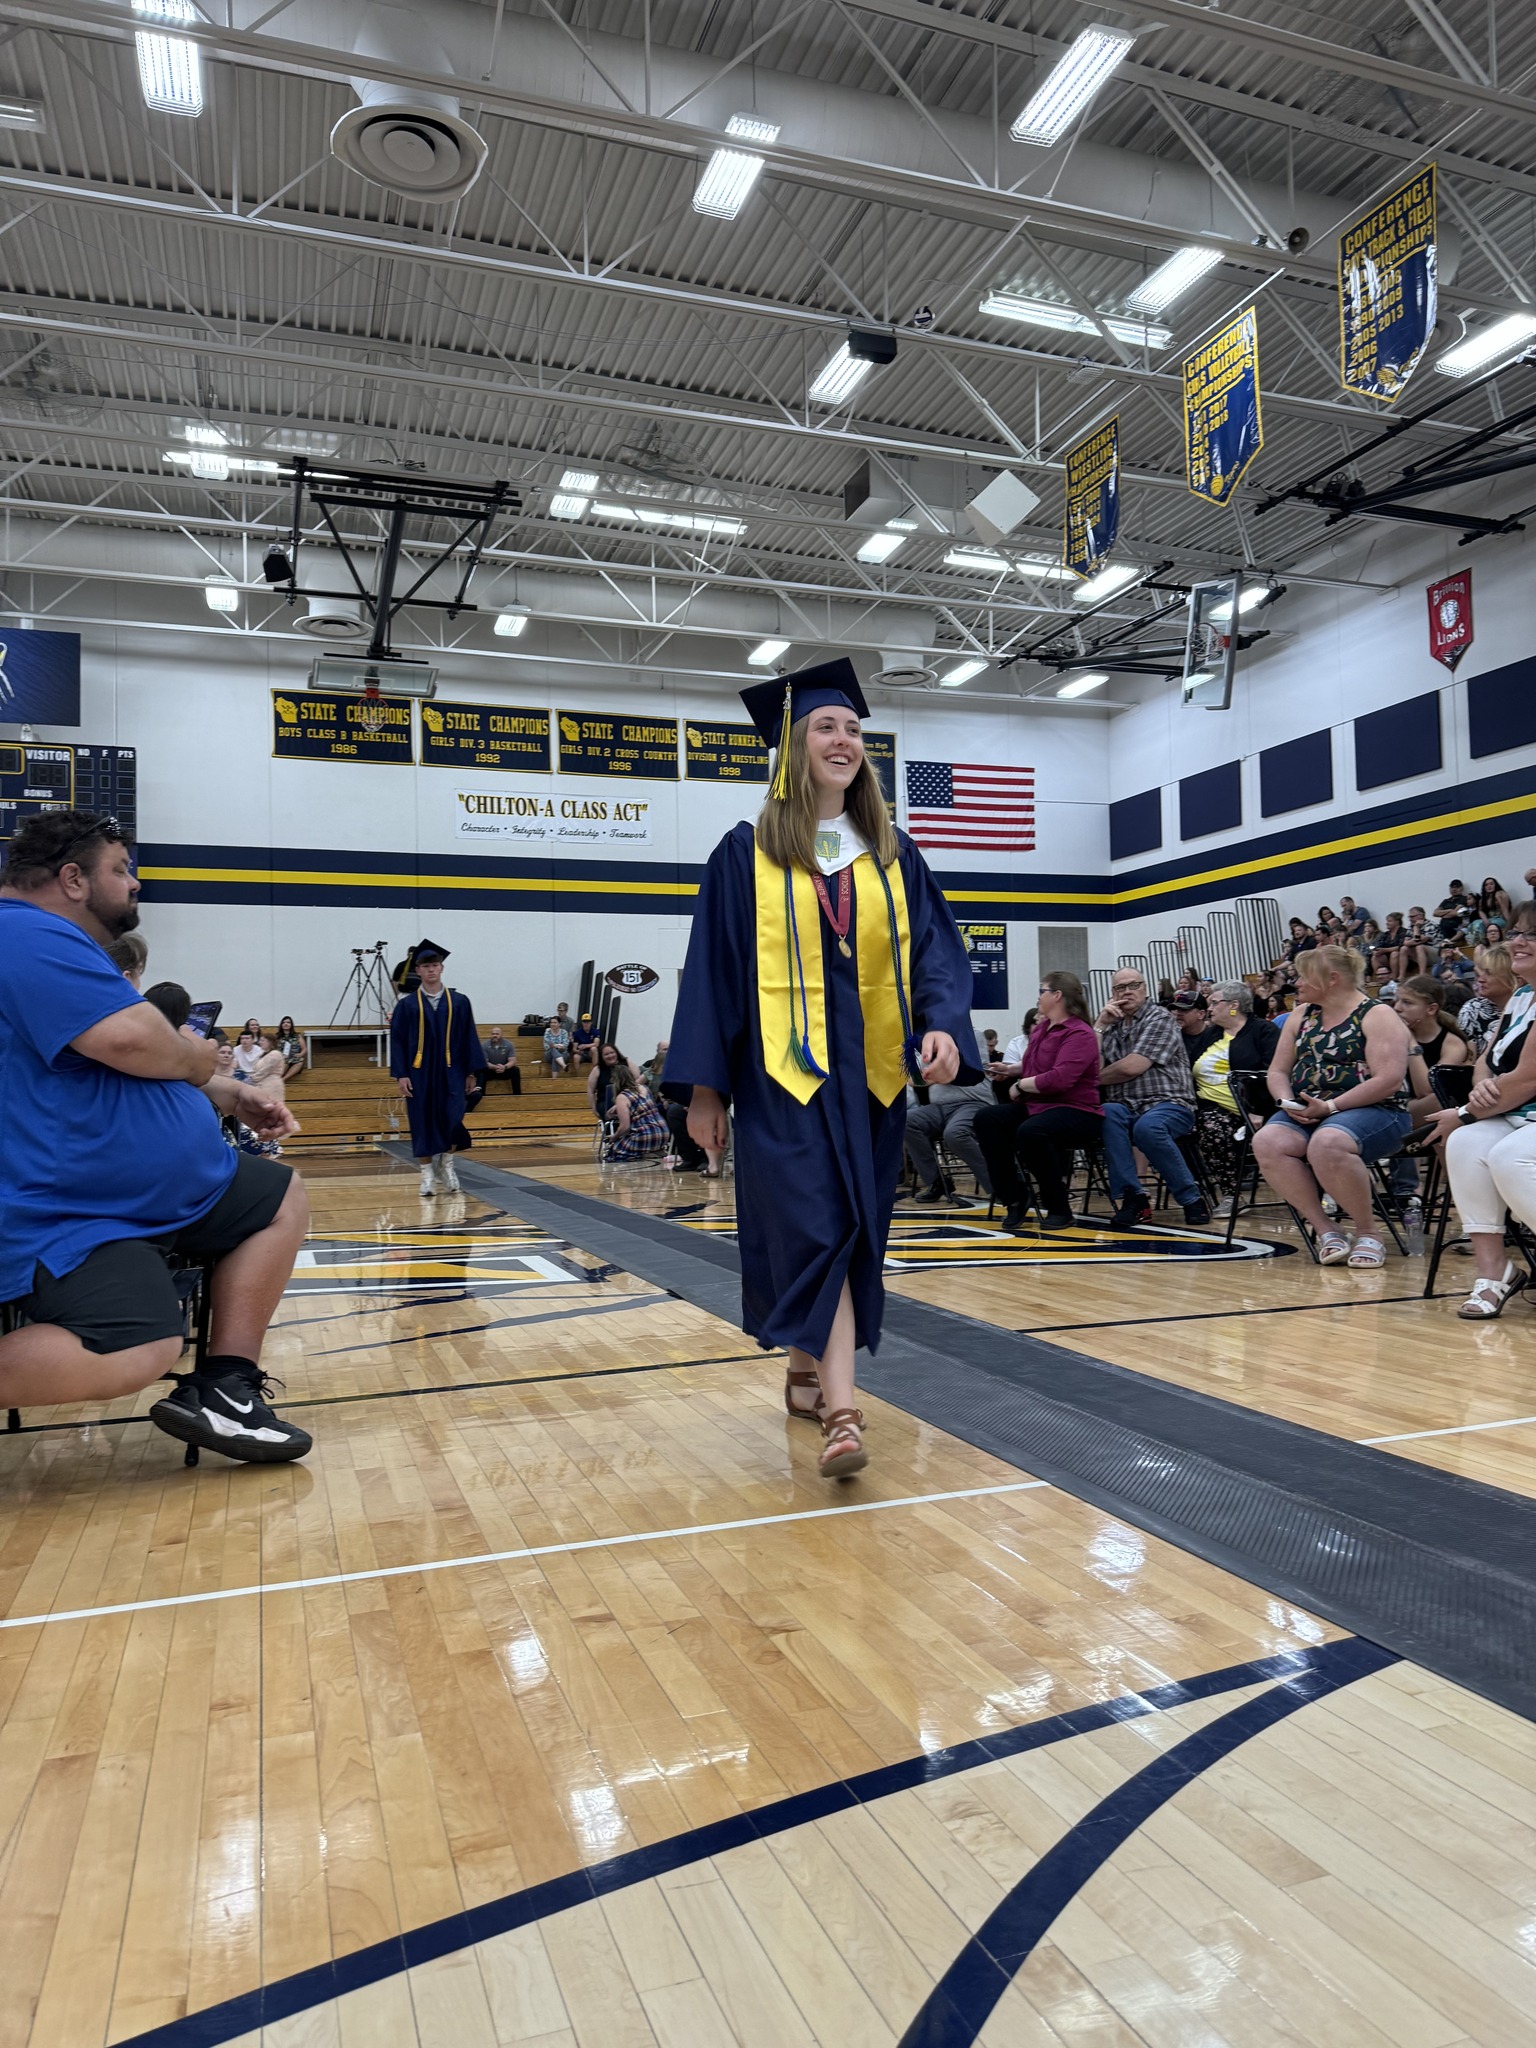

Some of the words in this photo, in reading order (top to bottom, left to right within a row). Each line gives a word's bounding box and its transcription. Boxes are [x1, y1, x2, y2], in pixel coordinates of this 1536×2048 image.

[1345, 176, 1430, 255] CONFERENCE
[1367, 224, 1396, 258] TRACK
[1397, 218, 1406, 237] &
[1408, 197, 1433, 230] FIELD
[1345, 218, 1433, 294] CAPIONSHIPS
[1376, 287, 1403, 315] 2009
[1350, 323, 1377, 351] 2005
[1378, 304, 1404, 332] 2013
[1187, 317, 1250, 378] CONFERENCE
[1208, 337, 1251, 380] VOLLEYBALL
[1349, 341, 1378, 366] 2006
[1348, 357, 1377, 383] 2007
[1209, 394, 1228, 418] 2017
[1069, 424, 1115, 470] CONFERENCE
[1071, 442, 1113, 483] WRESTLING
[1068, 457, 1117, 499] CHAMPIONSHIP
[300, 702, 337, 721] STATE
[346, 705, 410, 725] CHAMPIONS
[446, 712, 480, 731] STATE
[489, 716, 549, 736] CHAMPIONS
[278, 727, 302, 738] BOYS
[306, 728, 336, 739] CLASS
[340, 730, 347, 740] B
[352, 731, 409, 743] BASKETBALL
[430, 736, 455, 747] GIRLS
[459, 738, 476, 749] DIV.
[478, 740, 485, 749] 3
[489, 740, 543, 752] BASKETBALL
[582, 722, 614, 740] STATE
[622, 725, 677, 744] CHAMPIONS
[703, 732, 726, 745] STATE
[728, 733, 767, 747] RUNNER-U
[25, 749, 71, 762] VISITOR
[77, 748, 90, 756] NO
[102, 749, 109, 757] F
[117, 750, 134, 758] PTS
[330, 744, 358, 754] 1986
[475, 753, 501, 763] 1992
[560, 744, 583, 755] GIRLS
[587, 746, 602, 757] DIV.
[603, 748, 611, 757] 2
[615, 748, 640, 759] CROSS
[643, 750, 678, 761] COUNTRY
[687, 752, 717, 762] DIVISION
[720, 754, 727, 762] 2
[730, 754, 768, 764] WRESTLING
[608, 761, 632, 771] 1996
[718, 766, 741, 776] 1998
[23, 789, 53, 798] BONUS
[40, 803, 68, 811] FOULS
[457, 793, 555, 817] "CHILTON-A
[560, 799, 607, 820] CLASS
[613, 802, 648, 822] ACT"
[460, 822, 500, 833] Character
[511, 825, 546, 839] Integrity
[557, 827, 599, 839] Leadership
[609, 828, 647, 839] Teamwork
[967, 926, 1005, 936] SCORERS
[976, 942, 1004, 951] GIRLS
[625, 972, 640, 983] 151
